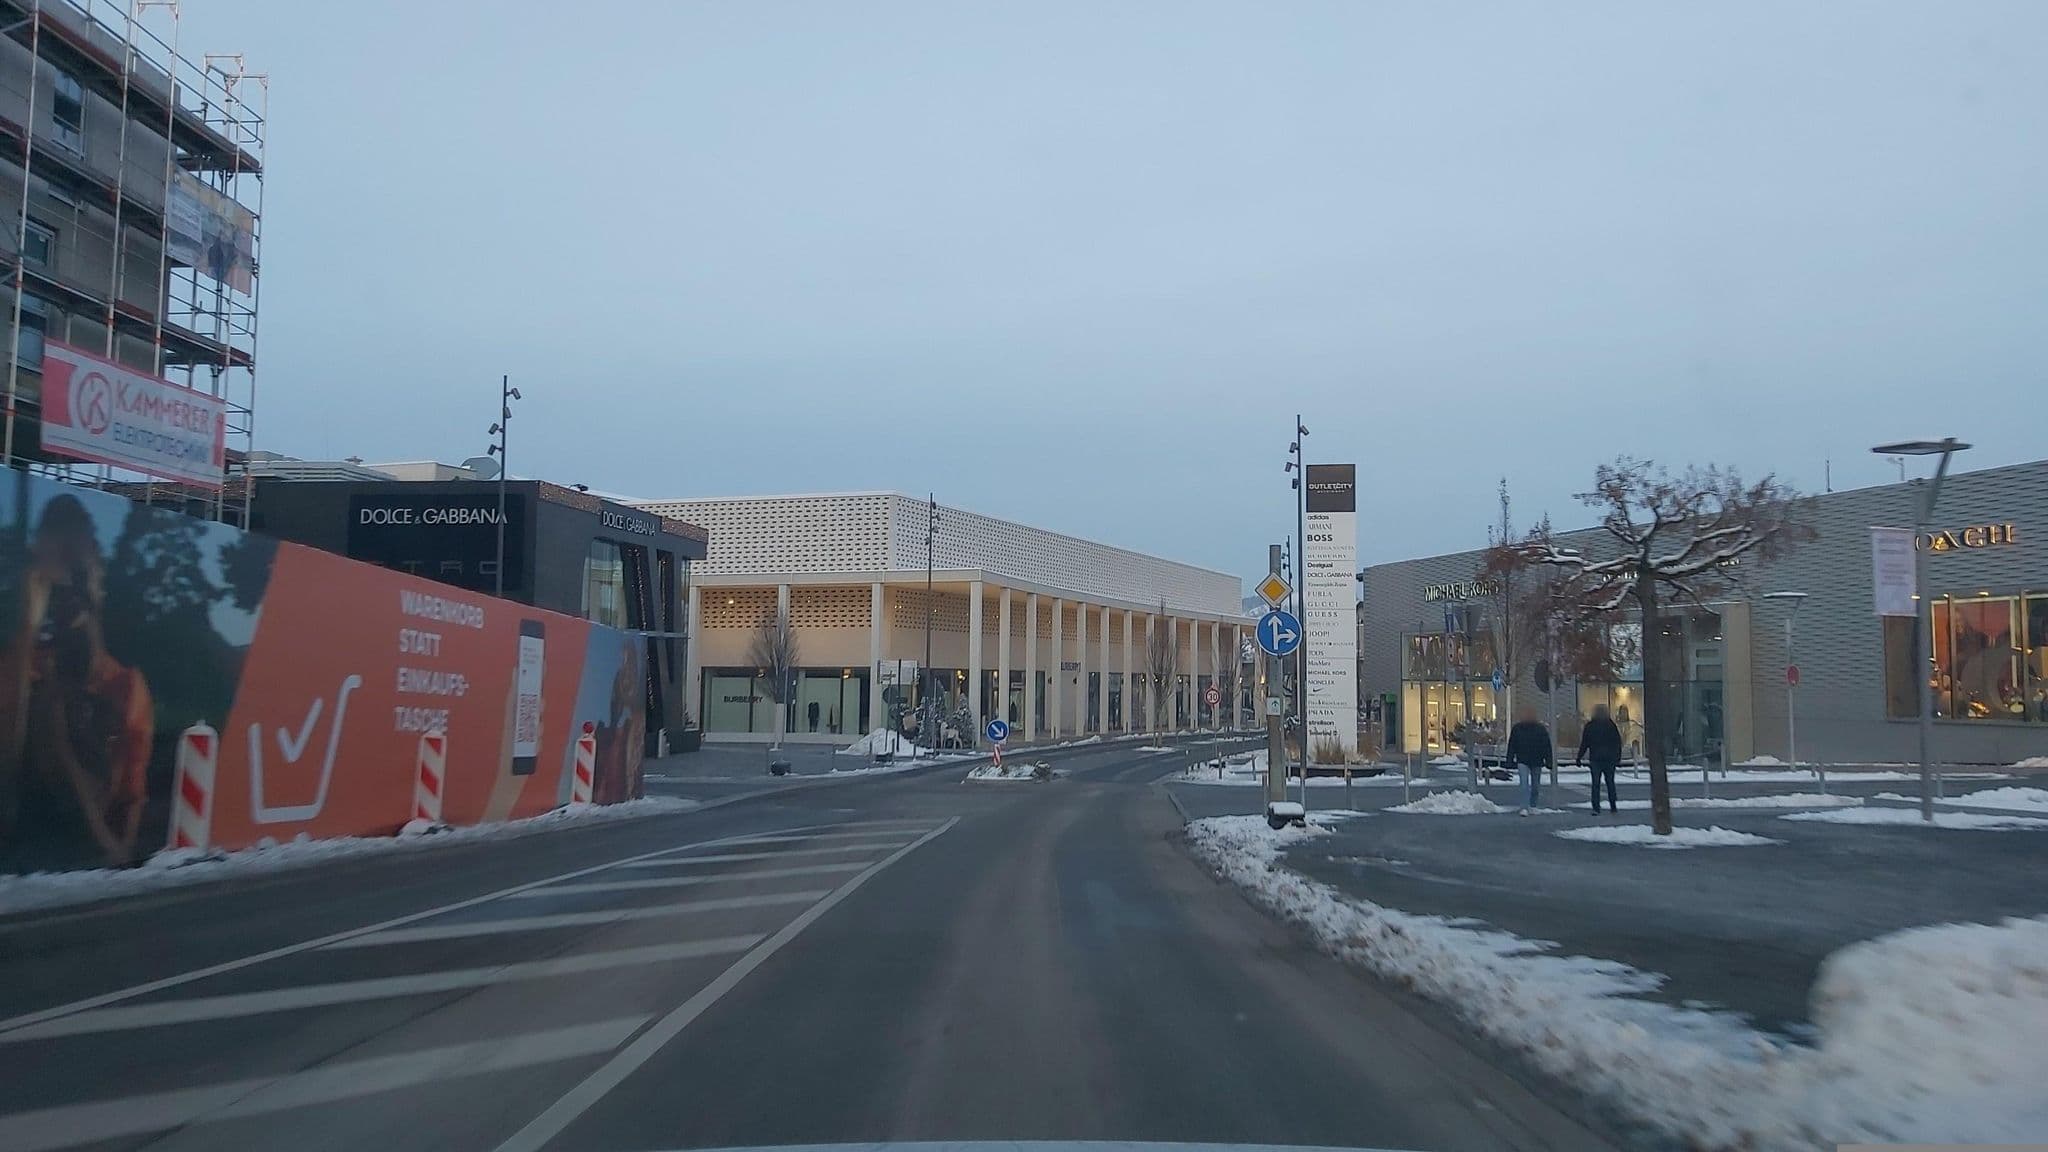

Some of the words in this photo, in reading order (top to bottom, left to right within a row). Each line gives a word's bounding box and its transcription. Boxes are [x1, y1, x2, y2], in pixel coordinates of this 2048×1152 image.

[115, 380, 209, 434] KAMMERER
[1308, 482, 1352, 490] OUTLETCITY
[360, 508, 412, 525] DOLCE
[422, 508, 508, 525] GABBANA
[602, 511, 624, 530] DOLCE
[1915, 523, 2017, 551] OACH
[400, 588, 485, 629] WARENKORB
[399, 628, 442, 657] STATT
[396, 667, 470, 697] EINKAUFS-
[1208, 692, 1218, 701] 30
[394, 706, 449, 734] TASCHE
